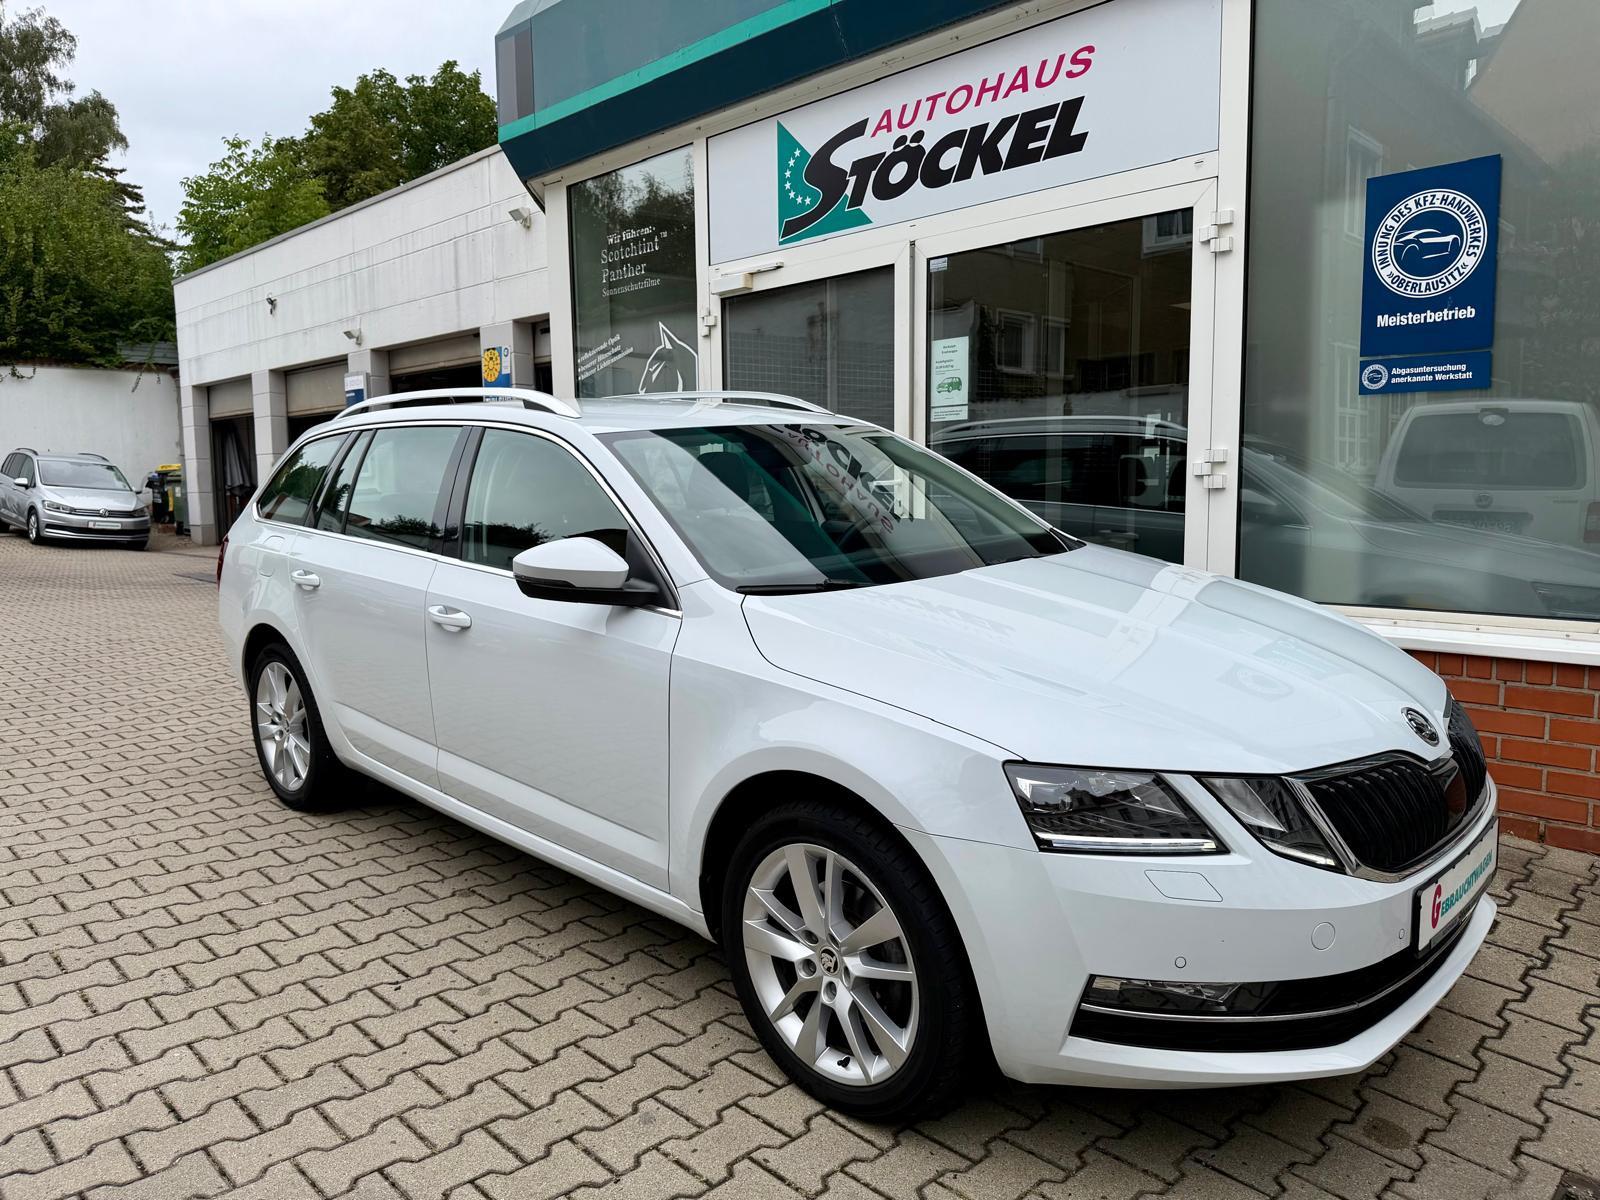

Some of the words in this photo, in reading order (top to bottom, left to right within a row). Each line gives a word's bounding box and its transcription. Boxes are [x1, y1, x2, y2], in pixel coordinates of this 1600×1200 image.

[870, 45, 1096, 138] AUTOHAUS
[780, 95, 1090, 241] STÖCKEL
[607, 233, 621, 245] Wir
[1377, 225, 1395, 270] INNUNG
[1391, 203, 1412, 223] DES
[1414, 194, 1483, 258] KFZ-HANDWERKES
[601, 236, 659, 264] Scotchtint
[602, 263, 647, 283] Panther
[1377, 305, 1476, 328] Meisterbetrieb
[1391, 364, 1467, 375] Abgasuntersuchung
[1391, 374, 1433, 384] anerkannte
[1435, 371, 1473, 381] Werkstatt
